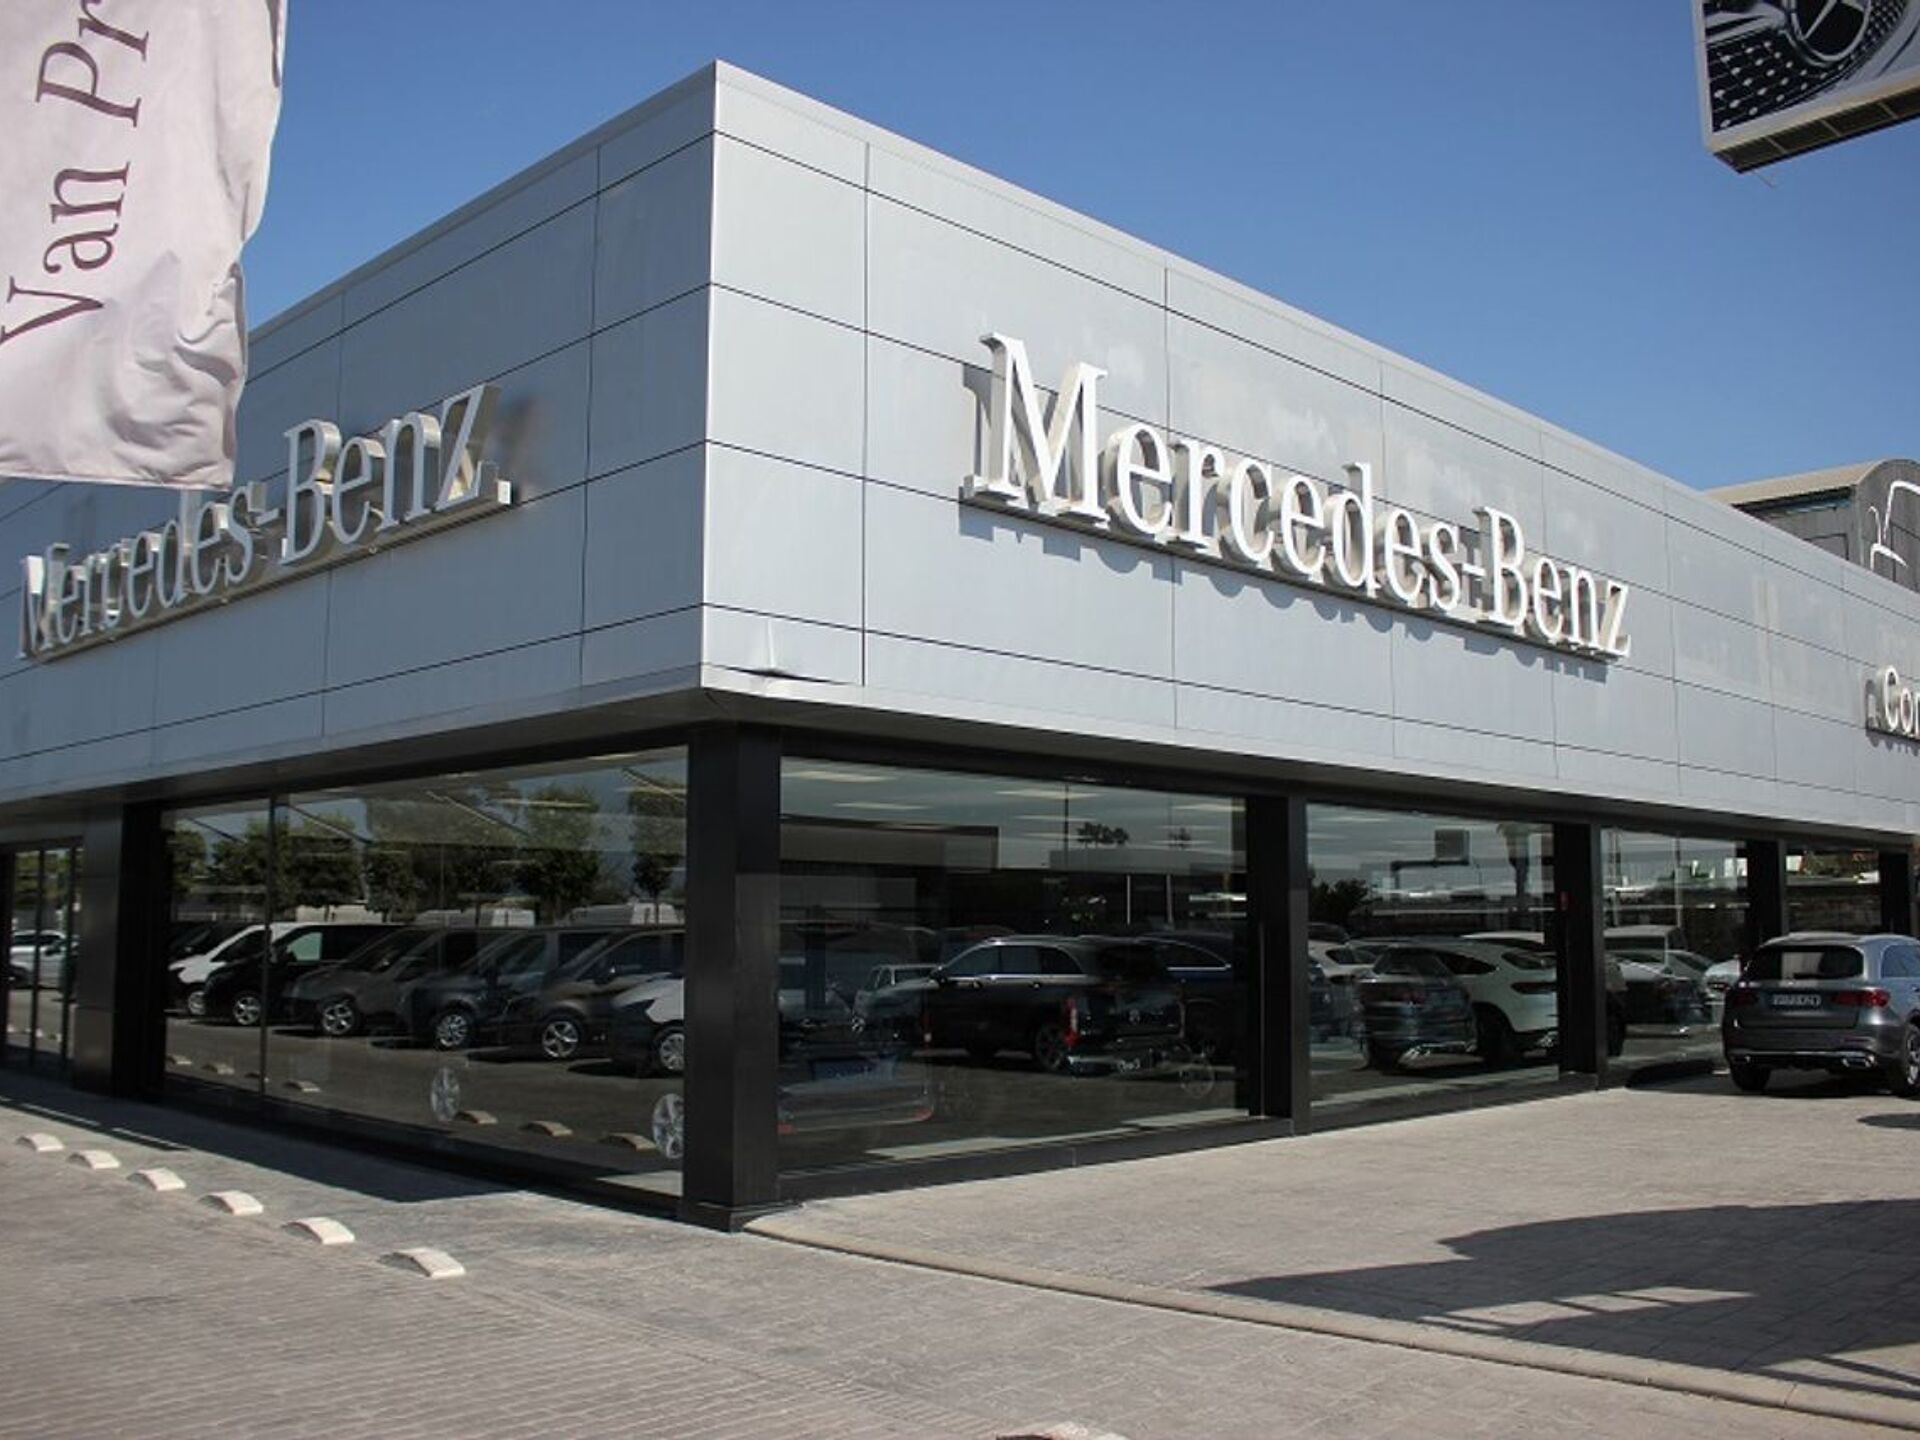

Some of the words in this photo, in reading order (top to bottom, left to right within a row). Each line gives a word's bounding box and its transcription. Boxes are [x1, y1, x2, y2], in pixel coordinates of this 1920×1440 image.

[0, 161, 131, 344] Van
[15, 383, 496, 660] Mercedes-Benz
[965, 331, 1633, 660] Mercedes-Benz
